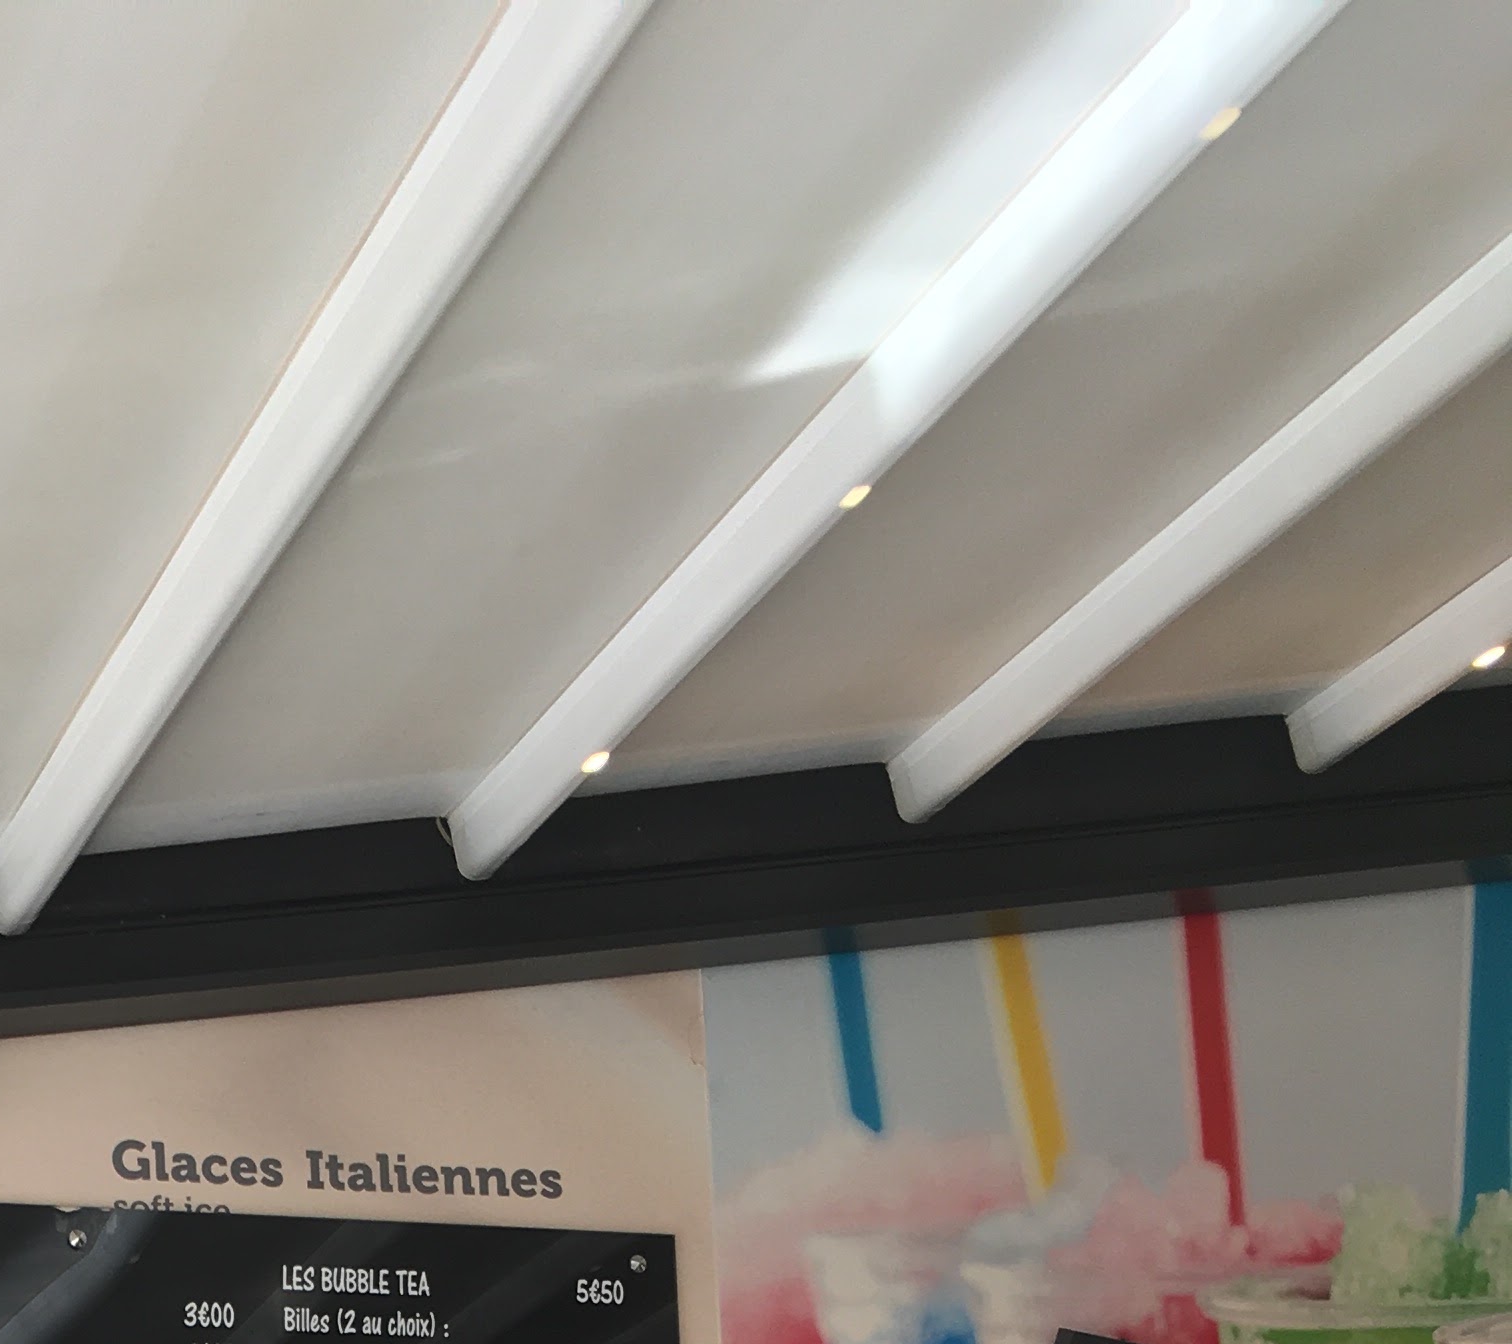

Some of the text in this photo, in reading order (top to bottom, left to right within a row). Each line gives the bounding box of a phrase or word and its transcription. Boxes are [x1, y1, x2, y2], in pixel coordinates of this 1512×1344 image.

[112, 1139, 563, 1200] Glaces Italiennes
[282, 1264, 624, 1305] LES BUBBLE TEA 5€50
[183, 1301, 235, 1328] 3€00
